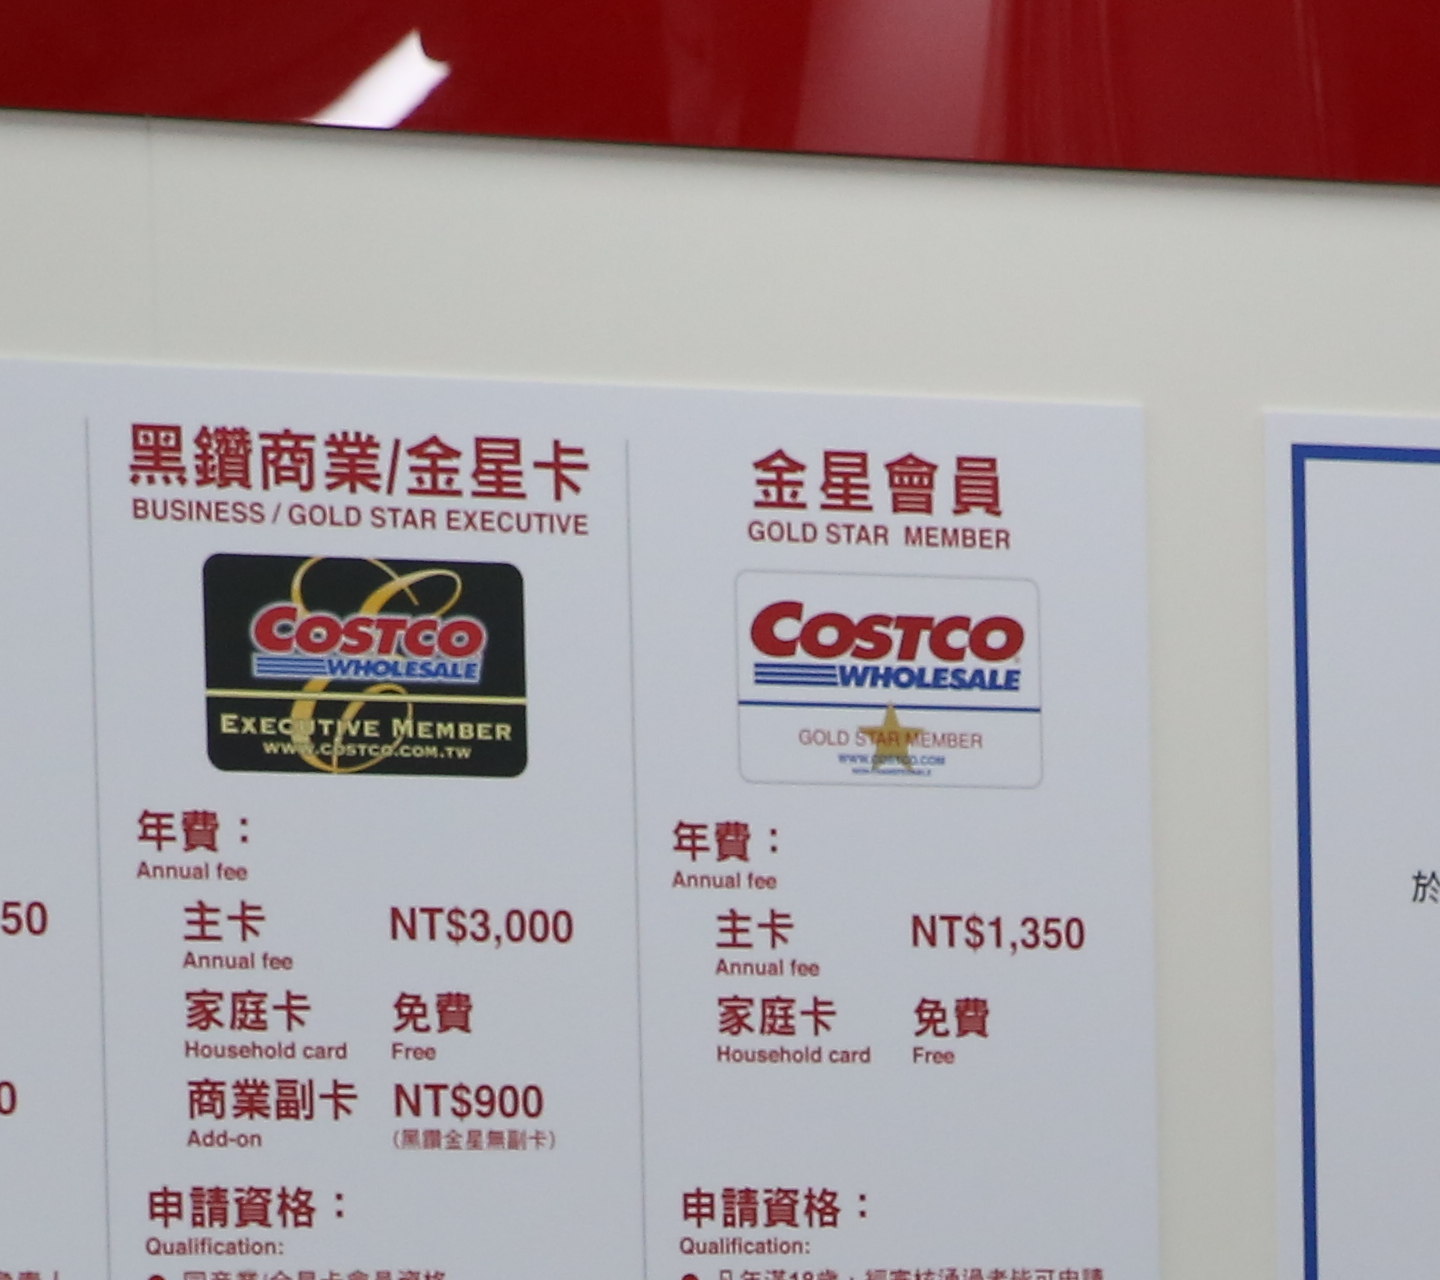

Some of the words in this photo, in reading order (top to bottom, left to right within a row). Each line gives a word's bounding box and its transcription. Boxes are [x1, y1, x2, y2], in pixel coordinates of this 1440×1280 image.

[128, 422, 590, 502] 黑鑽商業/金星卡
[752, 448, 1003, 517] 金星會員
[132, 497, 266, 525] BUSINESS
[287, 502, 363, 528] GOLD
[370, 506, 437, 530] STAR
[445, 508, 589, 536] EXECUTIVE
[747, 519, 818, 544] GOLD
[825, 522, 889, 546] STAR
[904, 525, 1011, 550] MEMBER
[253, 605, 484, 658] COSTCO
[749, 600, 1025, 661] COSTCO
[326, 657, 480, 682] WHOLESALE
[837, 664, 1021, 691] WHOLESALE
[219, 713, 381, 738] EXECUTIVE
[391, 717, 513, 741] MEMBER
[798, 729, 850, 747] GOLD
[905, 731, 983, 750] MEMBER
[183, 899, 266, 942] 主卡
[390, 906, 574, 948] NT$3,000
[715, 907, 795, 950] 主卡
[911, 913, 1085, 955] NT$1,350
[187, 1077, 359, 1121] 商業副卡
[394, 1082, 544, 1121] NT$900
[187, 1129, 262, 1149] Add-on
